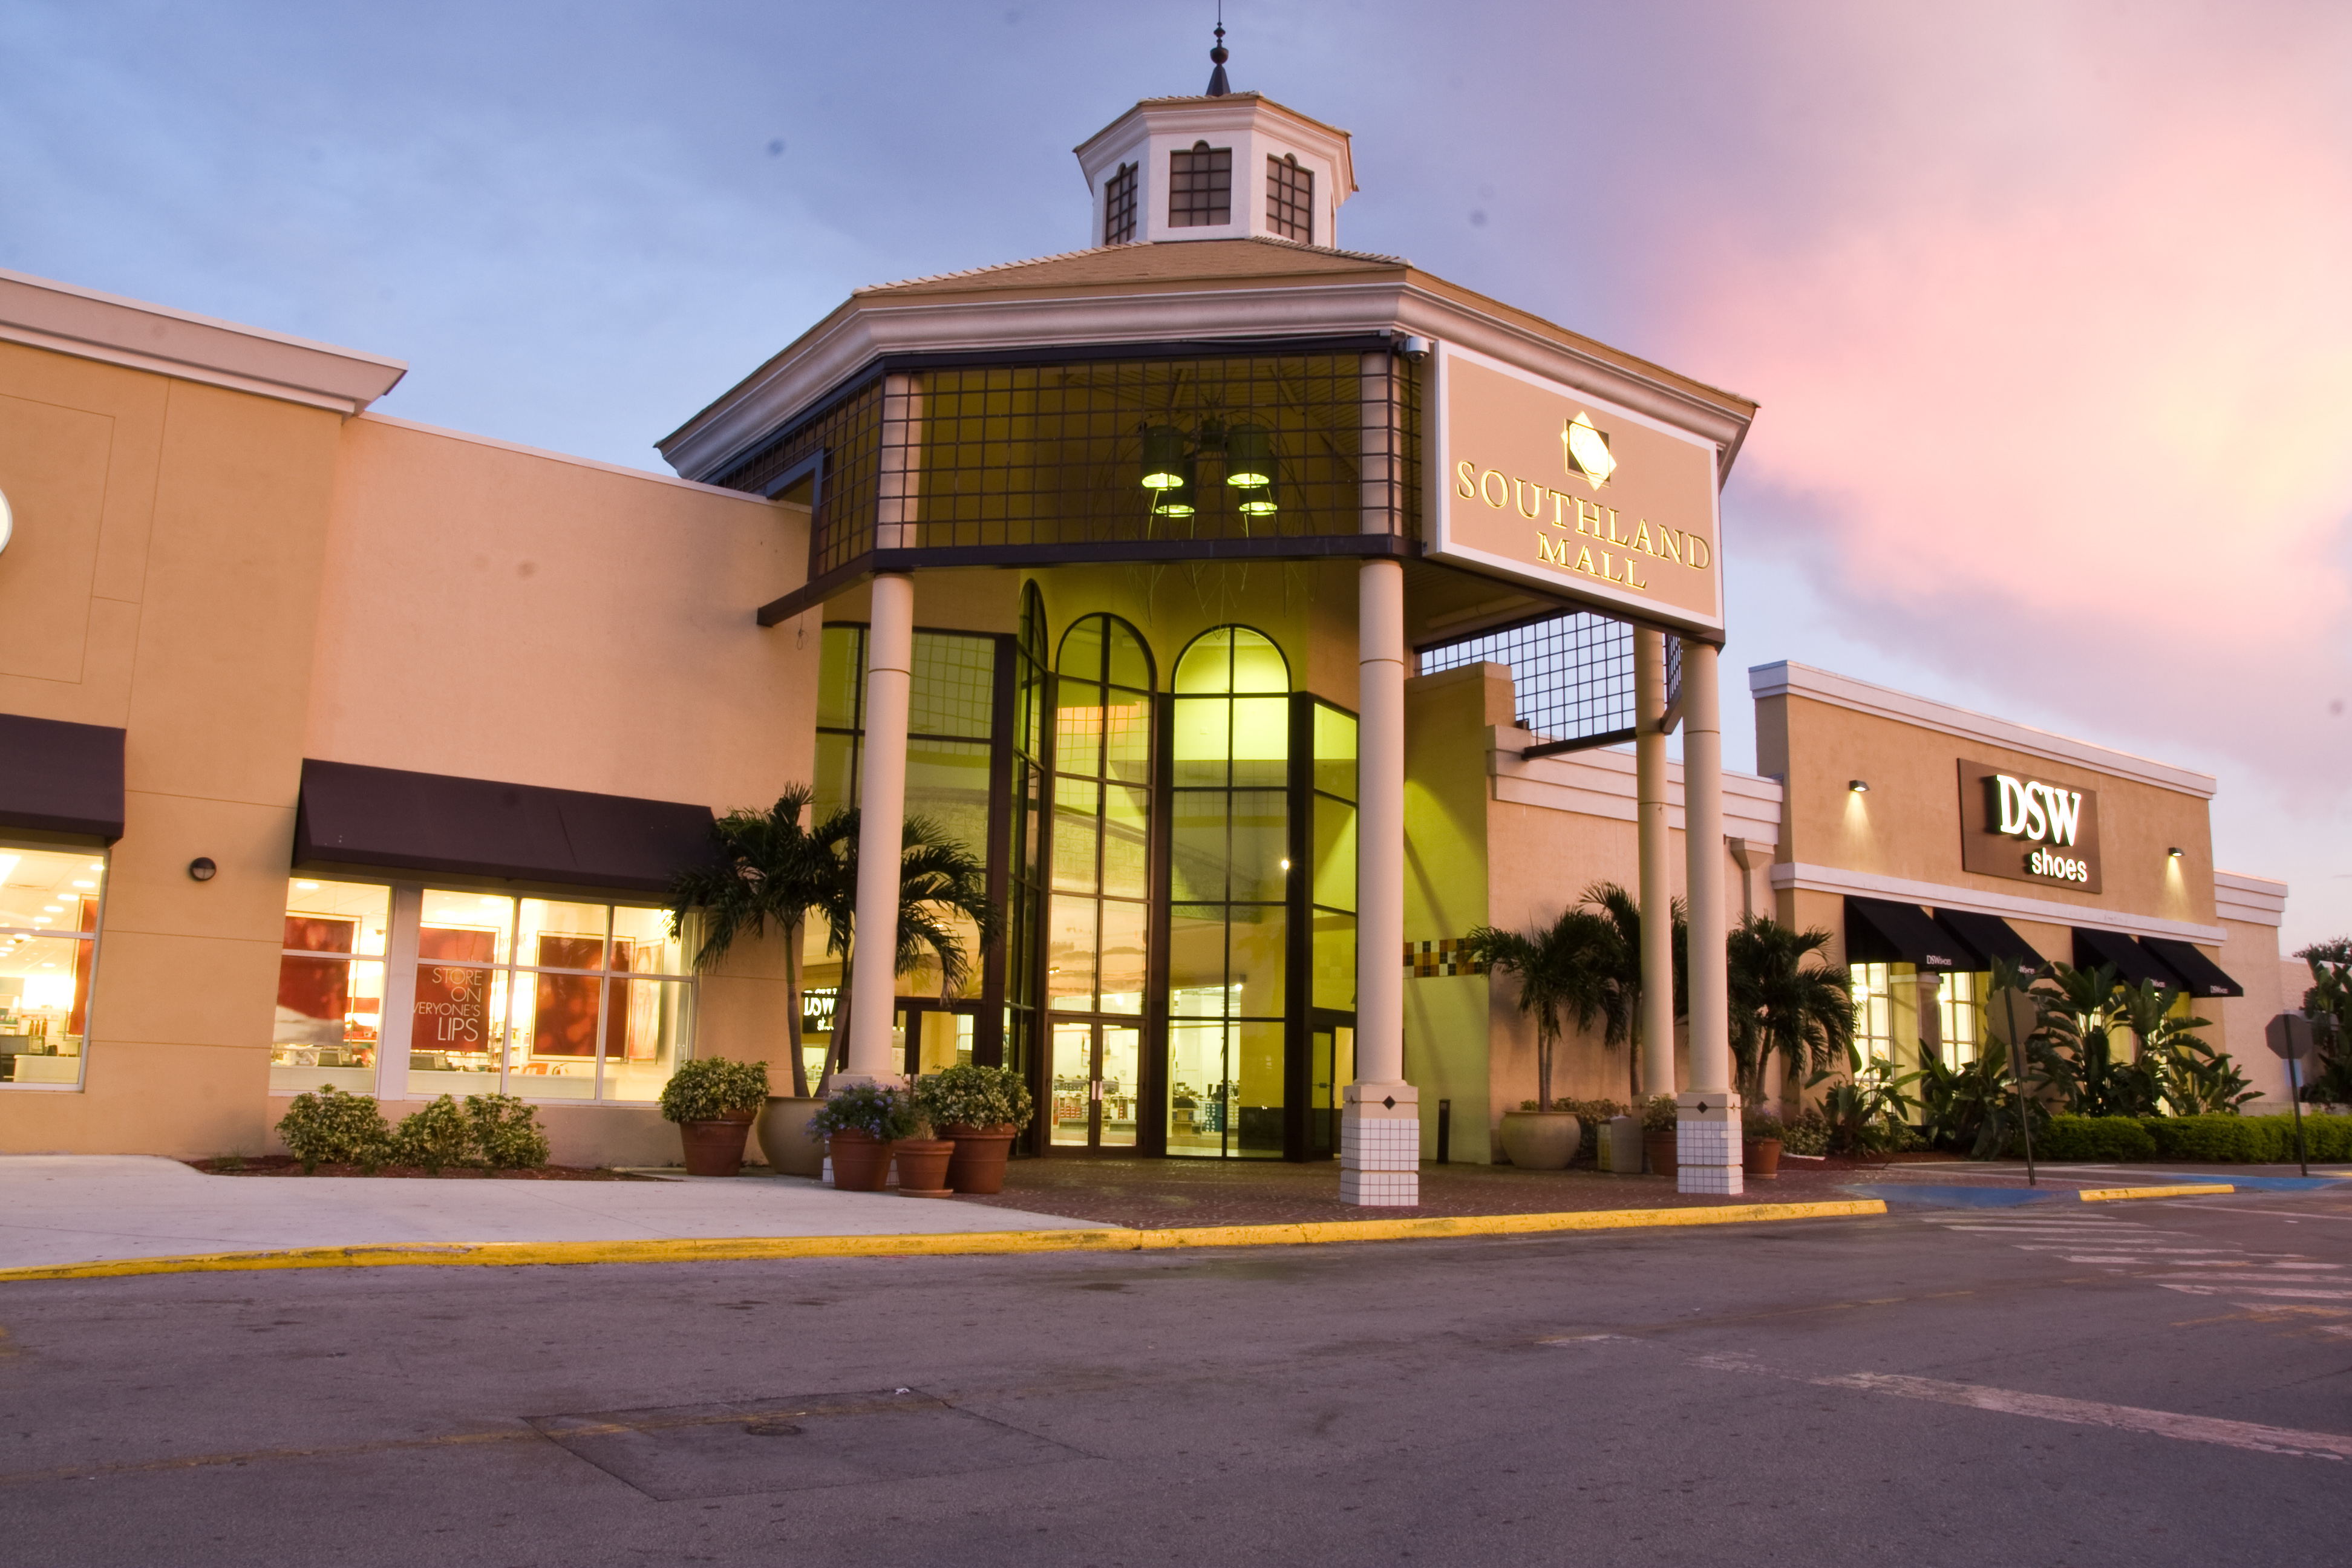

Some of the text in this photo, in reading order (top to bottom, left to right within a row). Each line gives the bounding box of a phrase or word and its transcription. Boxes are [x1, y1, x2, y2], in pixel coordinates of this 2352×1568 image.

[1456, 460, 1711, 570] SOUTHLAND
[1535, 531, 1647, 590] MALL
[1996, 774, 2082, 846] DSW
[2031, 848, 2088, 883] shoes
[432, 967, 483, 985] STORE
[451, 986, 482, 1003] ON
[414, 1002, 481, 1018] VERYONE'S
[438, 1017, 479, 1042] LIPS
